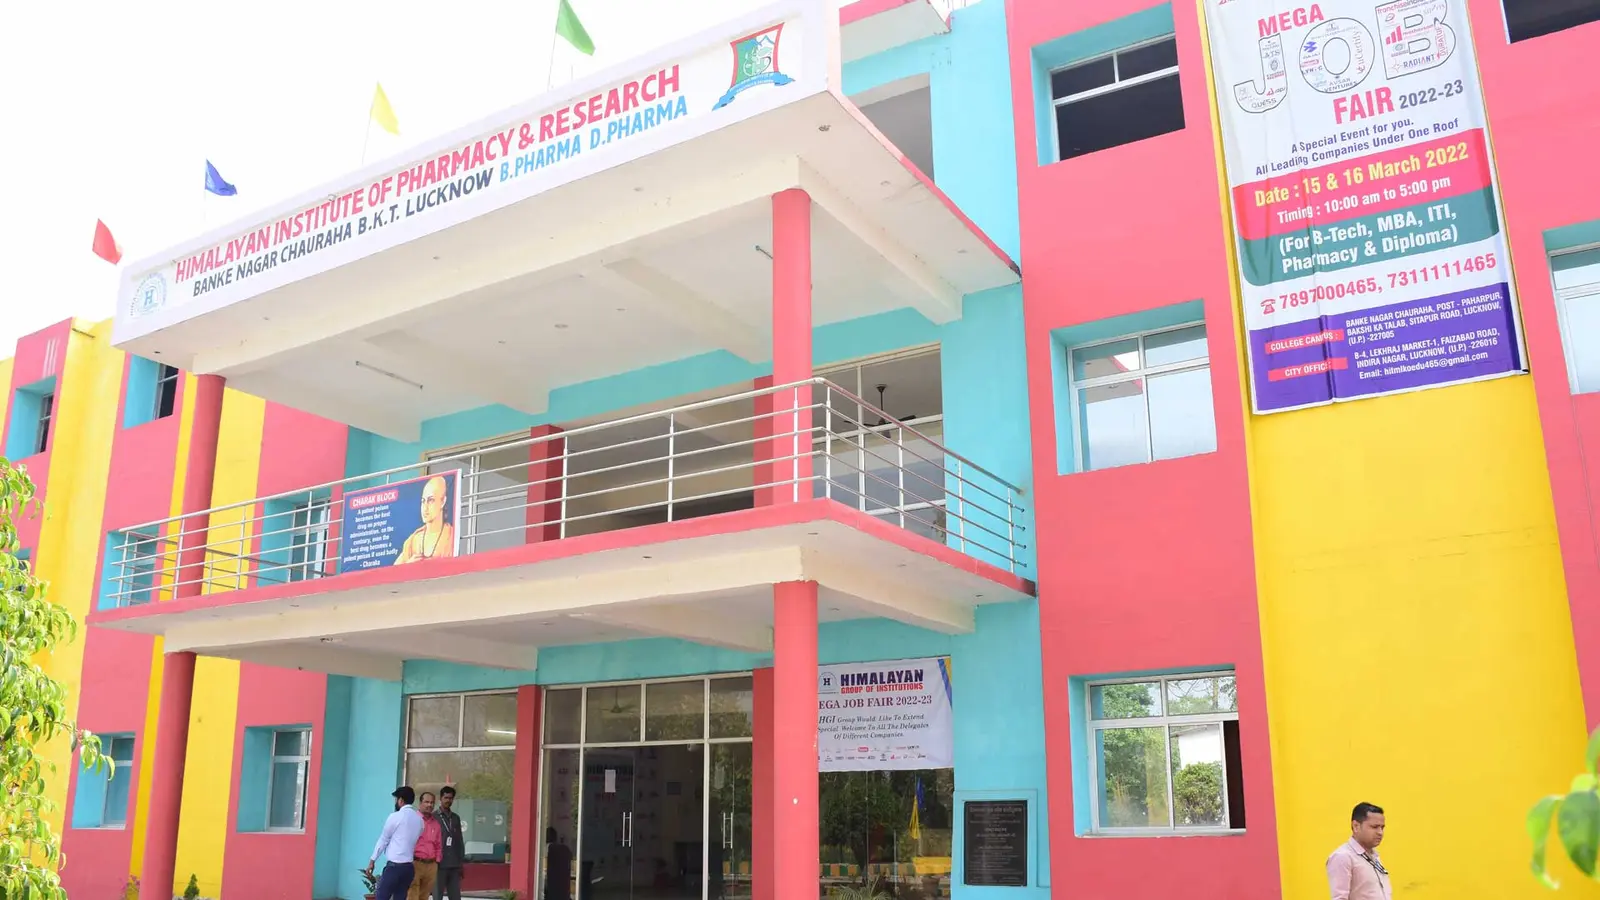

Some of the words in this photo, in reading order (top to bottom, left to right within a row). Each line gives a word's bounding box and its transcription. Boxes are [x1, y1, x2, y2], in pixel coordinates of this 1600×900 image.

[1257, 3, 1325, 38] MEGA
[1403, 53, 1435, 68] RADIANT
[1333, 86, 1395, 125] FAIR
[1399, 79, 1464, 110] 2022-23
[1256, 164, 1269, 176] All
[1271, 154, 1308, 172] Leading
[1312, 142, 1370, 162] Companies
[1373, 133, 1405, 148] Under
[1408, 127, 1430, 139] One
[1433, 117, 1460, 133] Roof
[1291, 144, 1298, 154] A
[1299, 134, 1338, 152] Special
[1340, 128, 1370, 144] Event
[1373, 123, 1388, 136] for
[1391, 118, 1414, 134] you.
[175, 226, 271, 284] HIMALAYAN
[272, 187, 364, 245] INSTITUTE
[367, 176, 393, 208] OF
[396, 128, 515, 198] PHARMACY
[518, 122, 535, 150] &
[538, 64, 680, 143] RESEARCH
[1255, 187, 1290, 207] Date
[1303, 177, 1321, 194] 15
[1326, 172, 1339, 191] &
[1344, 168, 1364, 187] 16
[1368, 154, 1421, 181] March
[1425, 142, 1469, 169] 2022
[193, 266, 233, 297] BANKE
[236, 250, 278, 281] NAGAR
[280, 222, 352, 263] CHAURAHA
[358, 204, 400, 235] B.K.T.
[406, 167, 494, 218] LUCKNOW
[500, 134, 581, 183] B.PHARMA
[590, 94, 688, 150] D.PHARMA
[1277, 205, 1313, 224] Timing
[1324, 195, 1359, 213] 10:00
[1362, 193, 1381, 206] am
[1384, 188, 1396, 201] to
[1400, 179, 1428, 198] 5:00
[1432, 176, 1451, 193] pm
[1279, 234, 1310, 256] (For
[1312, 222, 1373, 246] B-Tech,
[1377, 210, 1423, 233] MBA,
[1428, 203, 1457, 224] ITI,
[1282, 246, 1358, 274] Pharmacy
[1364, 239, 1378, 257] &
[1382, 223, 1458, 254] Diploma)
[1387, 252, 1497, 289] 7311111465
[1345, 316, 1369, 328] BANKE
[1370, 312, 1394, 323] NAGAR
[1436, 301, 1455, 311] POST
[1461, 291, 1503, 306] PAHARPUR,
[1347, 324, 1373, 336] BAKSHI
[1373, 323, 1383, 332] KA
[1409, 313, 1439, 326] SITAPUR
[1440, 309, 1462, 320] ROAD,
[1463, 301, 1502, 316] LUCKNOW,
[1270, 338, 1304, 351] COLLEGE
[1357, 358, 1381, 369] INDIRA
[1409, 346, 1447, 360] LUCKNOW,
[1369, 346, 1401, 357] LEKHRAJ
[1440, 331, 1476, 345] FAIZABAD
[1476, 327, 1500, 338] ROAD,
[1284, 366, 1302, 377] CITY
[1359, 369, 1383, 380] Email:
[352, 495, 376, 508] CHARAK
[376, 491, 396, 502] BLOCK
[823, 677, 831, 686] H
[840, 669, 924, 686] HIMALAYAN
[841, 685, 864, 695] GROUP
[865, 685, 874, 693] OF
[876, 682, 924, 692] INSTITUTIONS
[818, 699, 841, 710] EGA
[842, 698, 865, 708] JOB
[867, 696, 894, 708] FAIR
[895, 694, 932, 706] 2022-23
[818, 715, 836, 724] HGI
[878, 714, 892, 722] Like
[902, 713, 924, 721] Extend
[842, 732, 869, 740] Different
